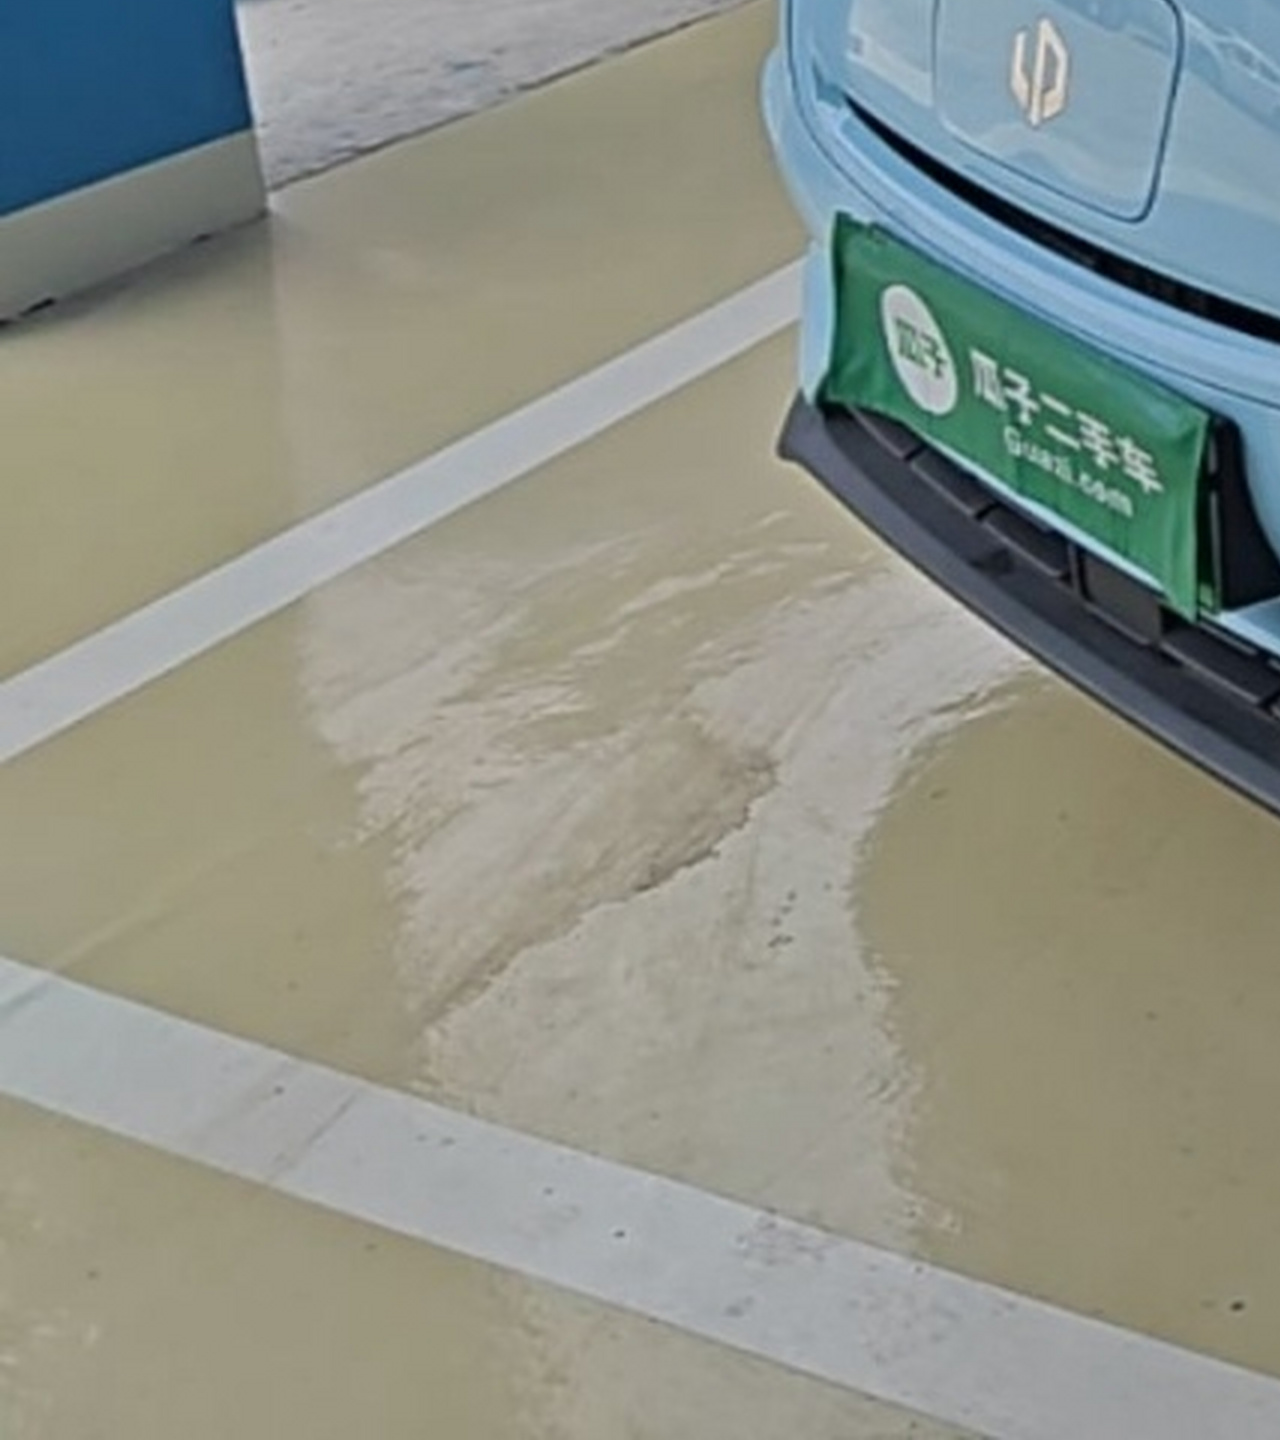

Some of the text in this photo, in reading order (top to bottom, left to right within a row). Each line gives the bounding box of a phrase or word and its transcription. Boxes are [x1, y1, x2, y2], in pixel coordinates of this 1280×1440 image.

[969, 347, 1163, 494] 瓜子二手车
